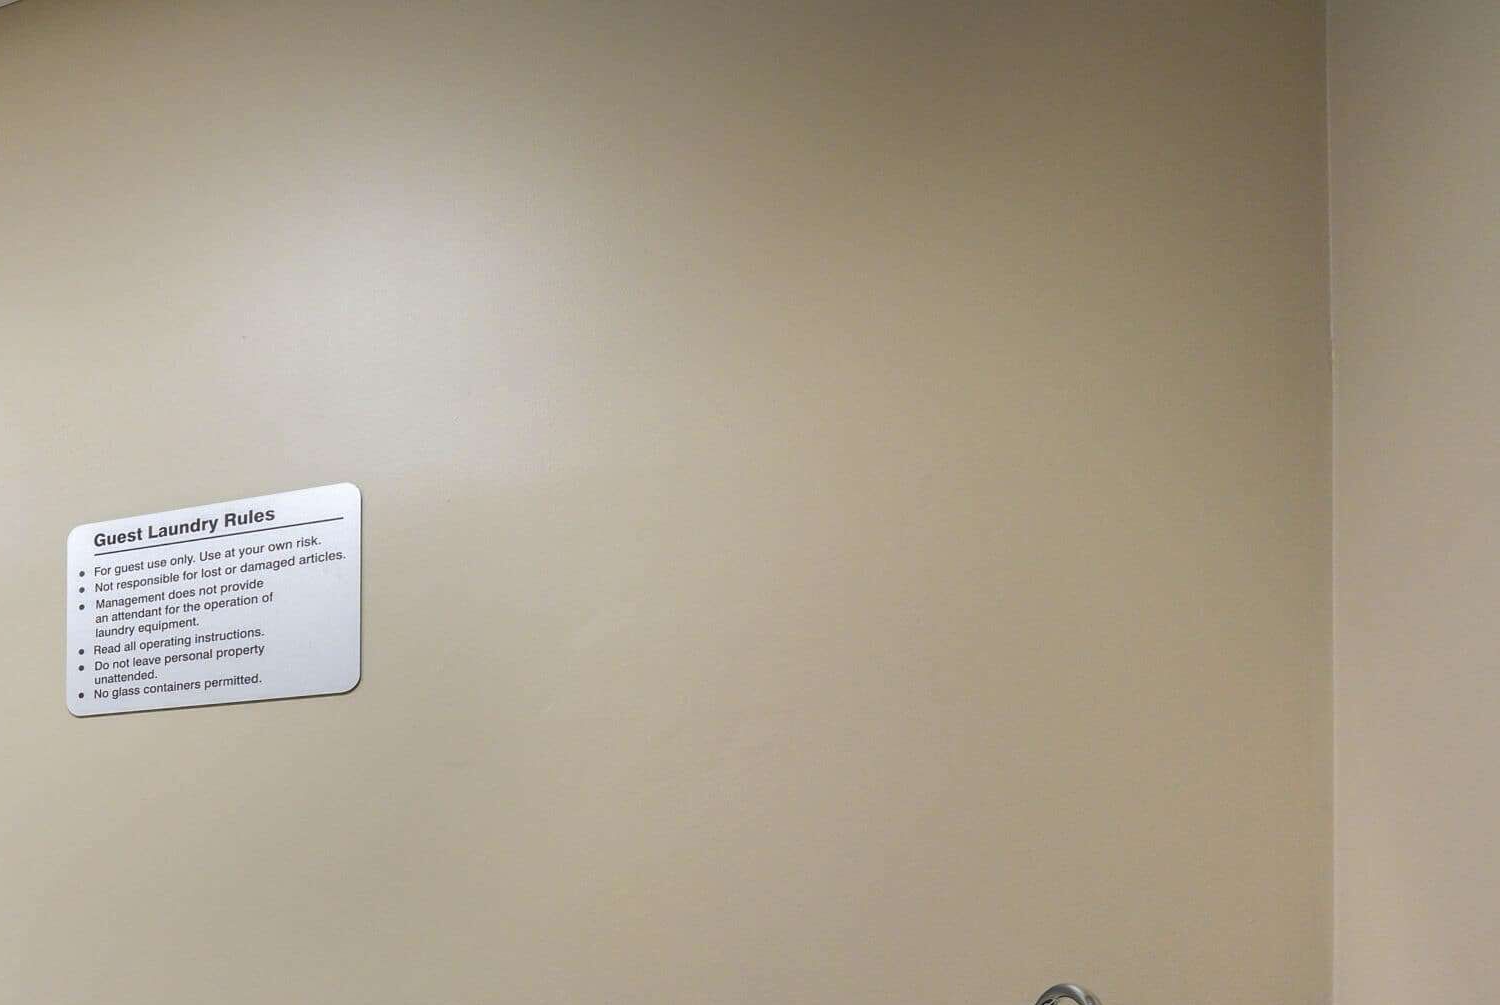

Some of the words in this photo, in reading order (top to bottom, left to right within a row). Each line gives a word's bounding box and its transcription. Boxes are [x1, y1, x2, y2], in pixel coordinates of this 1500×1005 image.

[94, 528, 142, 547] Guest
[148, 518, 218, 539] Laundry
[224, 508, 275, 527] Rules
[94, 566, 112, 576] For
[114, 563, 144, 576] guest
[147, 558, 167, 568] use
[170, 554, 195, 566] only.
[199, 551, 222, 562] Use
[225, 548, 236, 558] at
[239, 544, 264, 558] your
[268, 541, 292, 551] own
[296, 536, 321, 548] risk.
[95, 581, 113, 592] Not
[116, 572, 180, 590] responsible
[182, 569, 198, 580] for
[201, 567, 222, 578] lost
[225, 566, 237, 575] or
[240, 557, 295, 573] damaged
[299, 552, 346, 565] articles.
[96, 592, 165, 610] Management
[168, 588, 196, 599] does
[199, 585, 217, 596] not
[220, 578, 264, 594] provide
[96, 614, 108, 623] an
[111, 606, 162, 622] attendant
[165, 603, 180, 614] for
[183, 602, 201, 612] the
[204, 596, 259, 612] operation
[262, 592, 273, 603] of
[94, 643, 121, 655] Read
[124, 641, 136, 653] all
[139, 635, 191, 650] operating
[195, 628, 264, 643] instructions.
[96, 625, 135, 638] laundry
[138, 617, 199, 634] equipment.
[95, 661, 110, 671] Do
[112, 658, 130, 669] not
[133, 655, 161, 668] leave
[164, 649, 213, 664] personal
[216, 644, 265, 659] property
[94, 670, 157, 685] unattended.
[94, 688, 109, 699] No
[112, 685, 140, 700] glass
[143, 680, 201, 694] containers
[204, 673, 262, 688] permitted.
